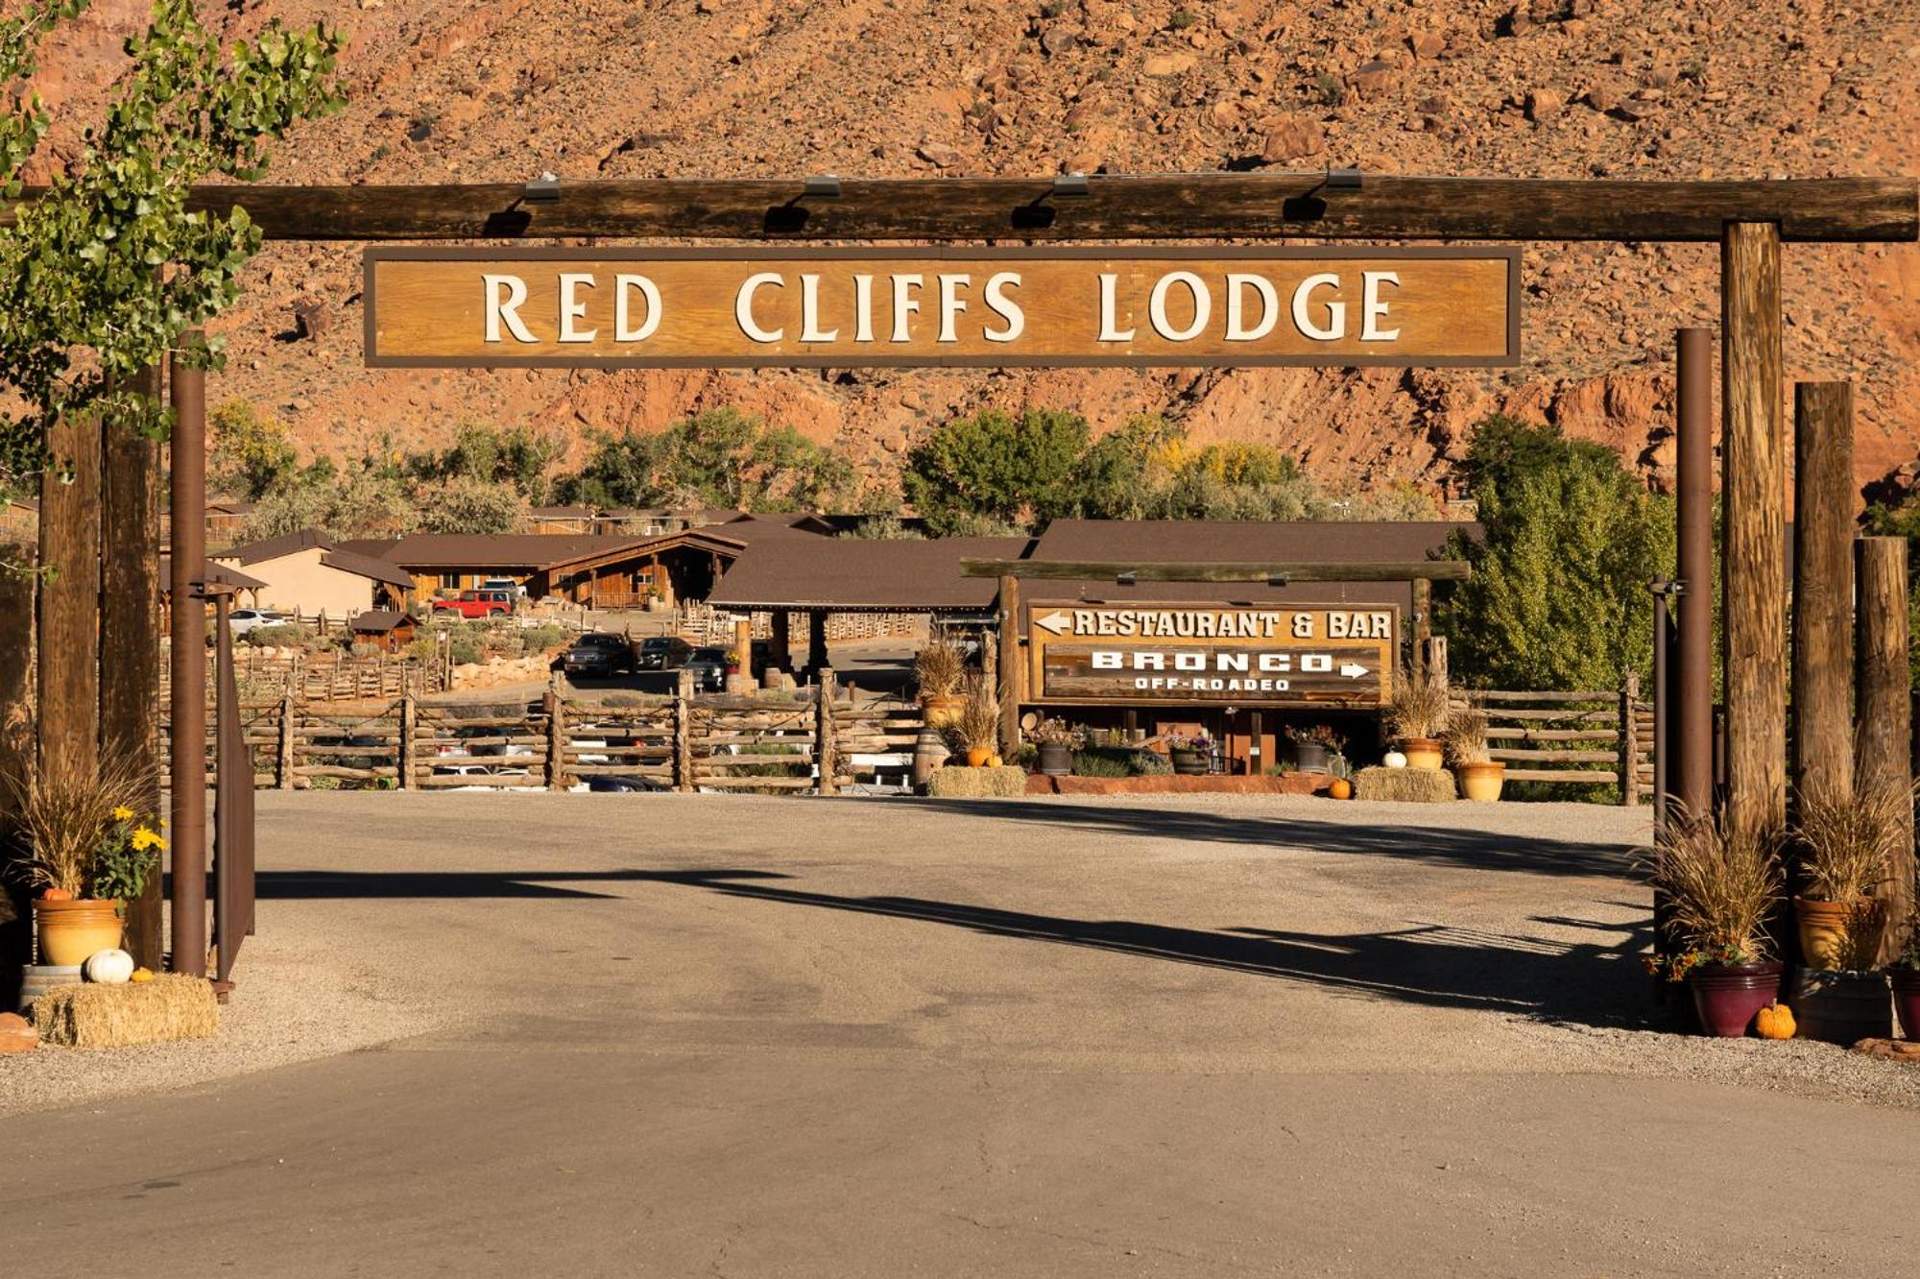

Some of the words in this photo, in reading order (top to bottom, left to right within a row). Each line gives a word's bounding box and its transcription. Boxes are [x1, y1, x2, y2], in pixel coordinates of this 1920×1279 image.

[483, 273, 663, 344] RED
[735, 272, 1025, 344] CLIFFS
[1098, 272, 1401, 343] LODGE
[1073, 610, 1279, 638] RESTAURANT
[1292, 613, 1313, 638] &
[1327, 612, 1391, 639] BAR
[1091, 651, 1333, 672] BRONCO
[1134, 677, 1290, 692] OFF-ROADEO
